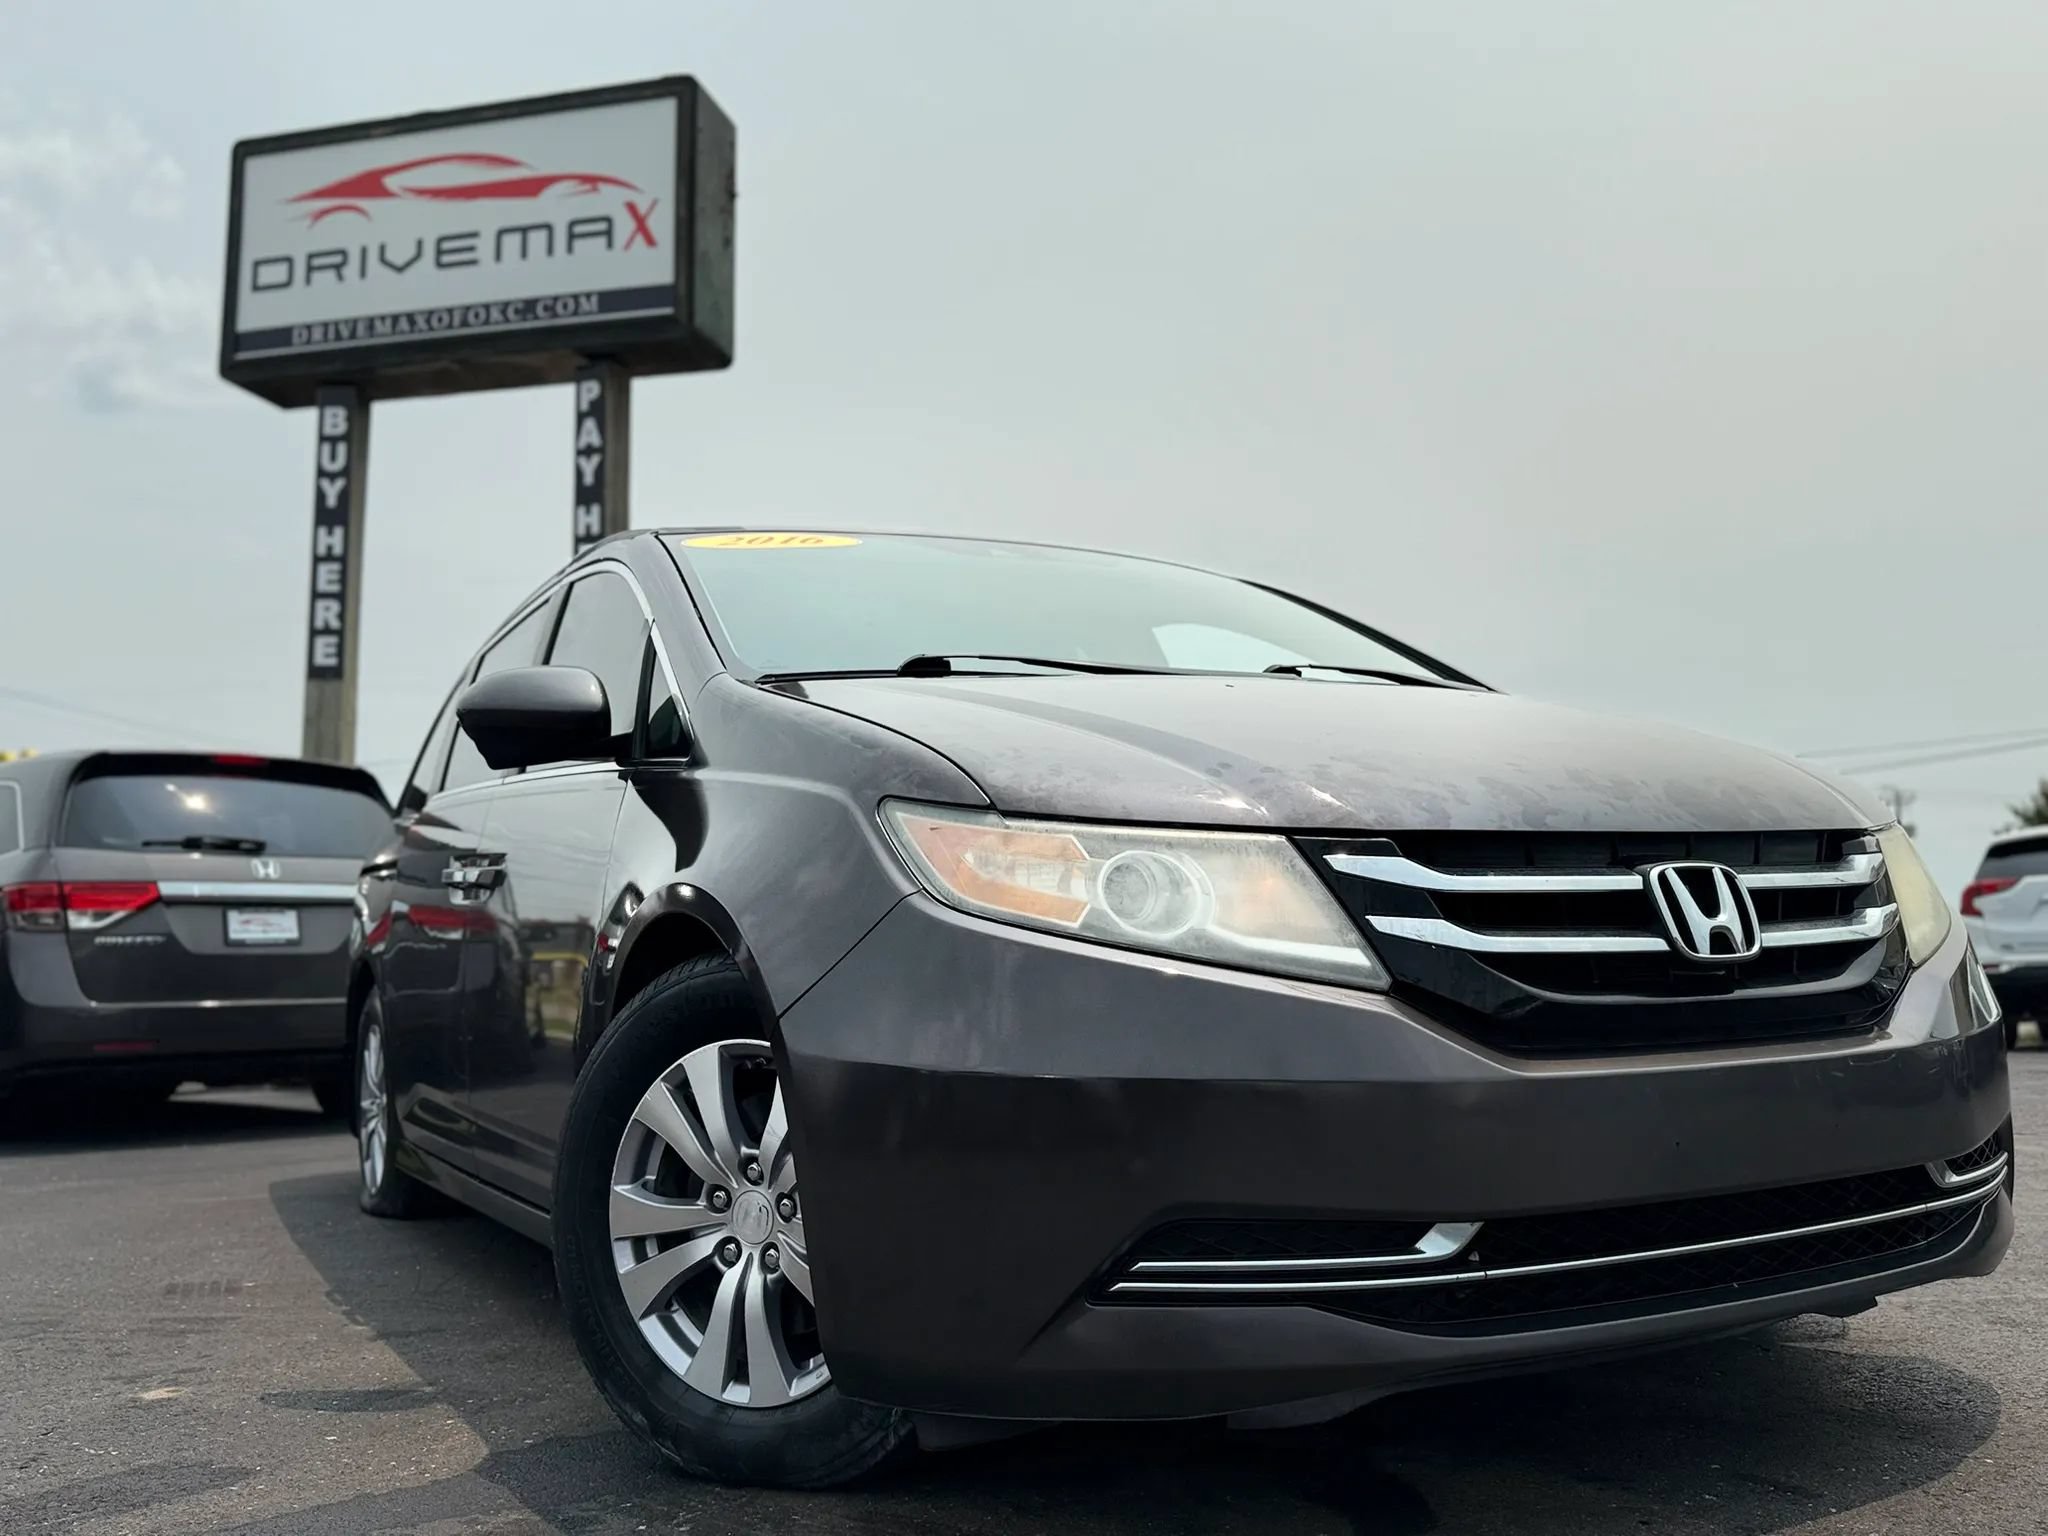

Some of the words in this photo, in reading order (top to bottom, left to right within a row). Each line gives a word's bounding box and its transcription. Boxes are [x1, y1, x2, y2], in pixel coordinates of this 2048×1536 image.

[251, 199, 658, 292] DRIVEMAX
[291, 294, 600, 347] DRIVEMAXOFOKC.COM
[318, 405, 349, 508] BUY
[577, 379, 602, 486] PAY
[576, 502, 602, 555] H
[719, 536, 824, 546] 2016
[312, 525, 345, 667] HERE
